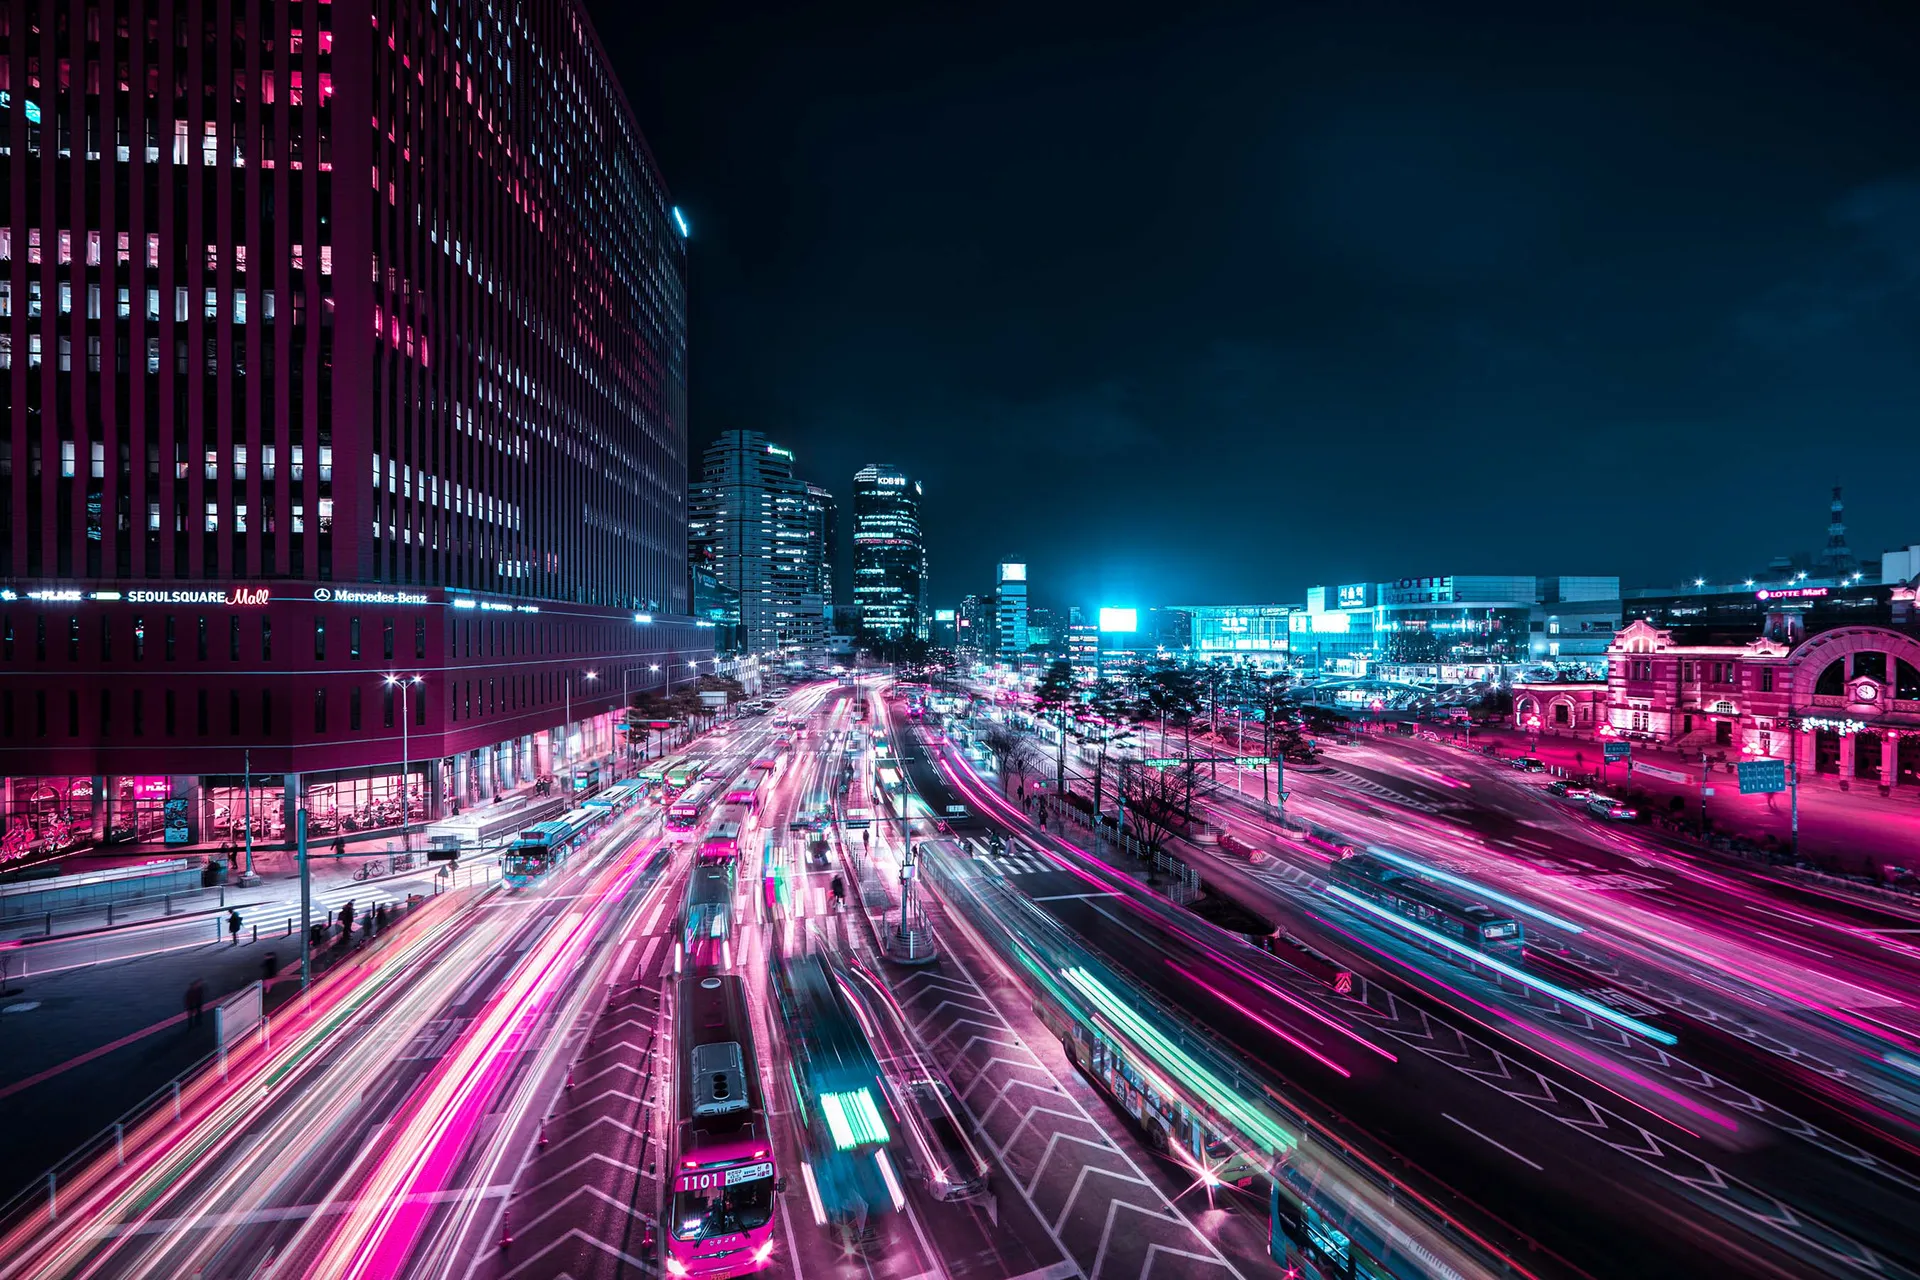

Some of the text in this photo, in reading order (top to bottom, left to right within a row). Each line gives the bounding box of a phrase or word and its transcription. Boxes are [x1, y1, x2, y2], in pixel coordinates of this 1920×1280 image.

[1392, 576, 1452, 591] LOTTE
[128, 591, 226, 602] SEOULSQUARE
[225, 588, 269, 605] Mall
[334, 589, 428, 604] Mercedes-Benz
[1802, 588, 1828, 596] Mart
[683, 1173, 718, 1191] 1101
